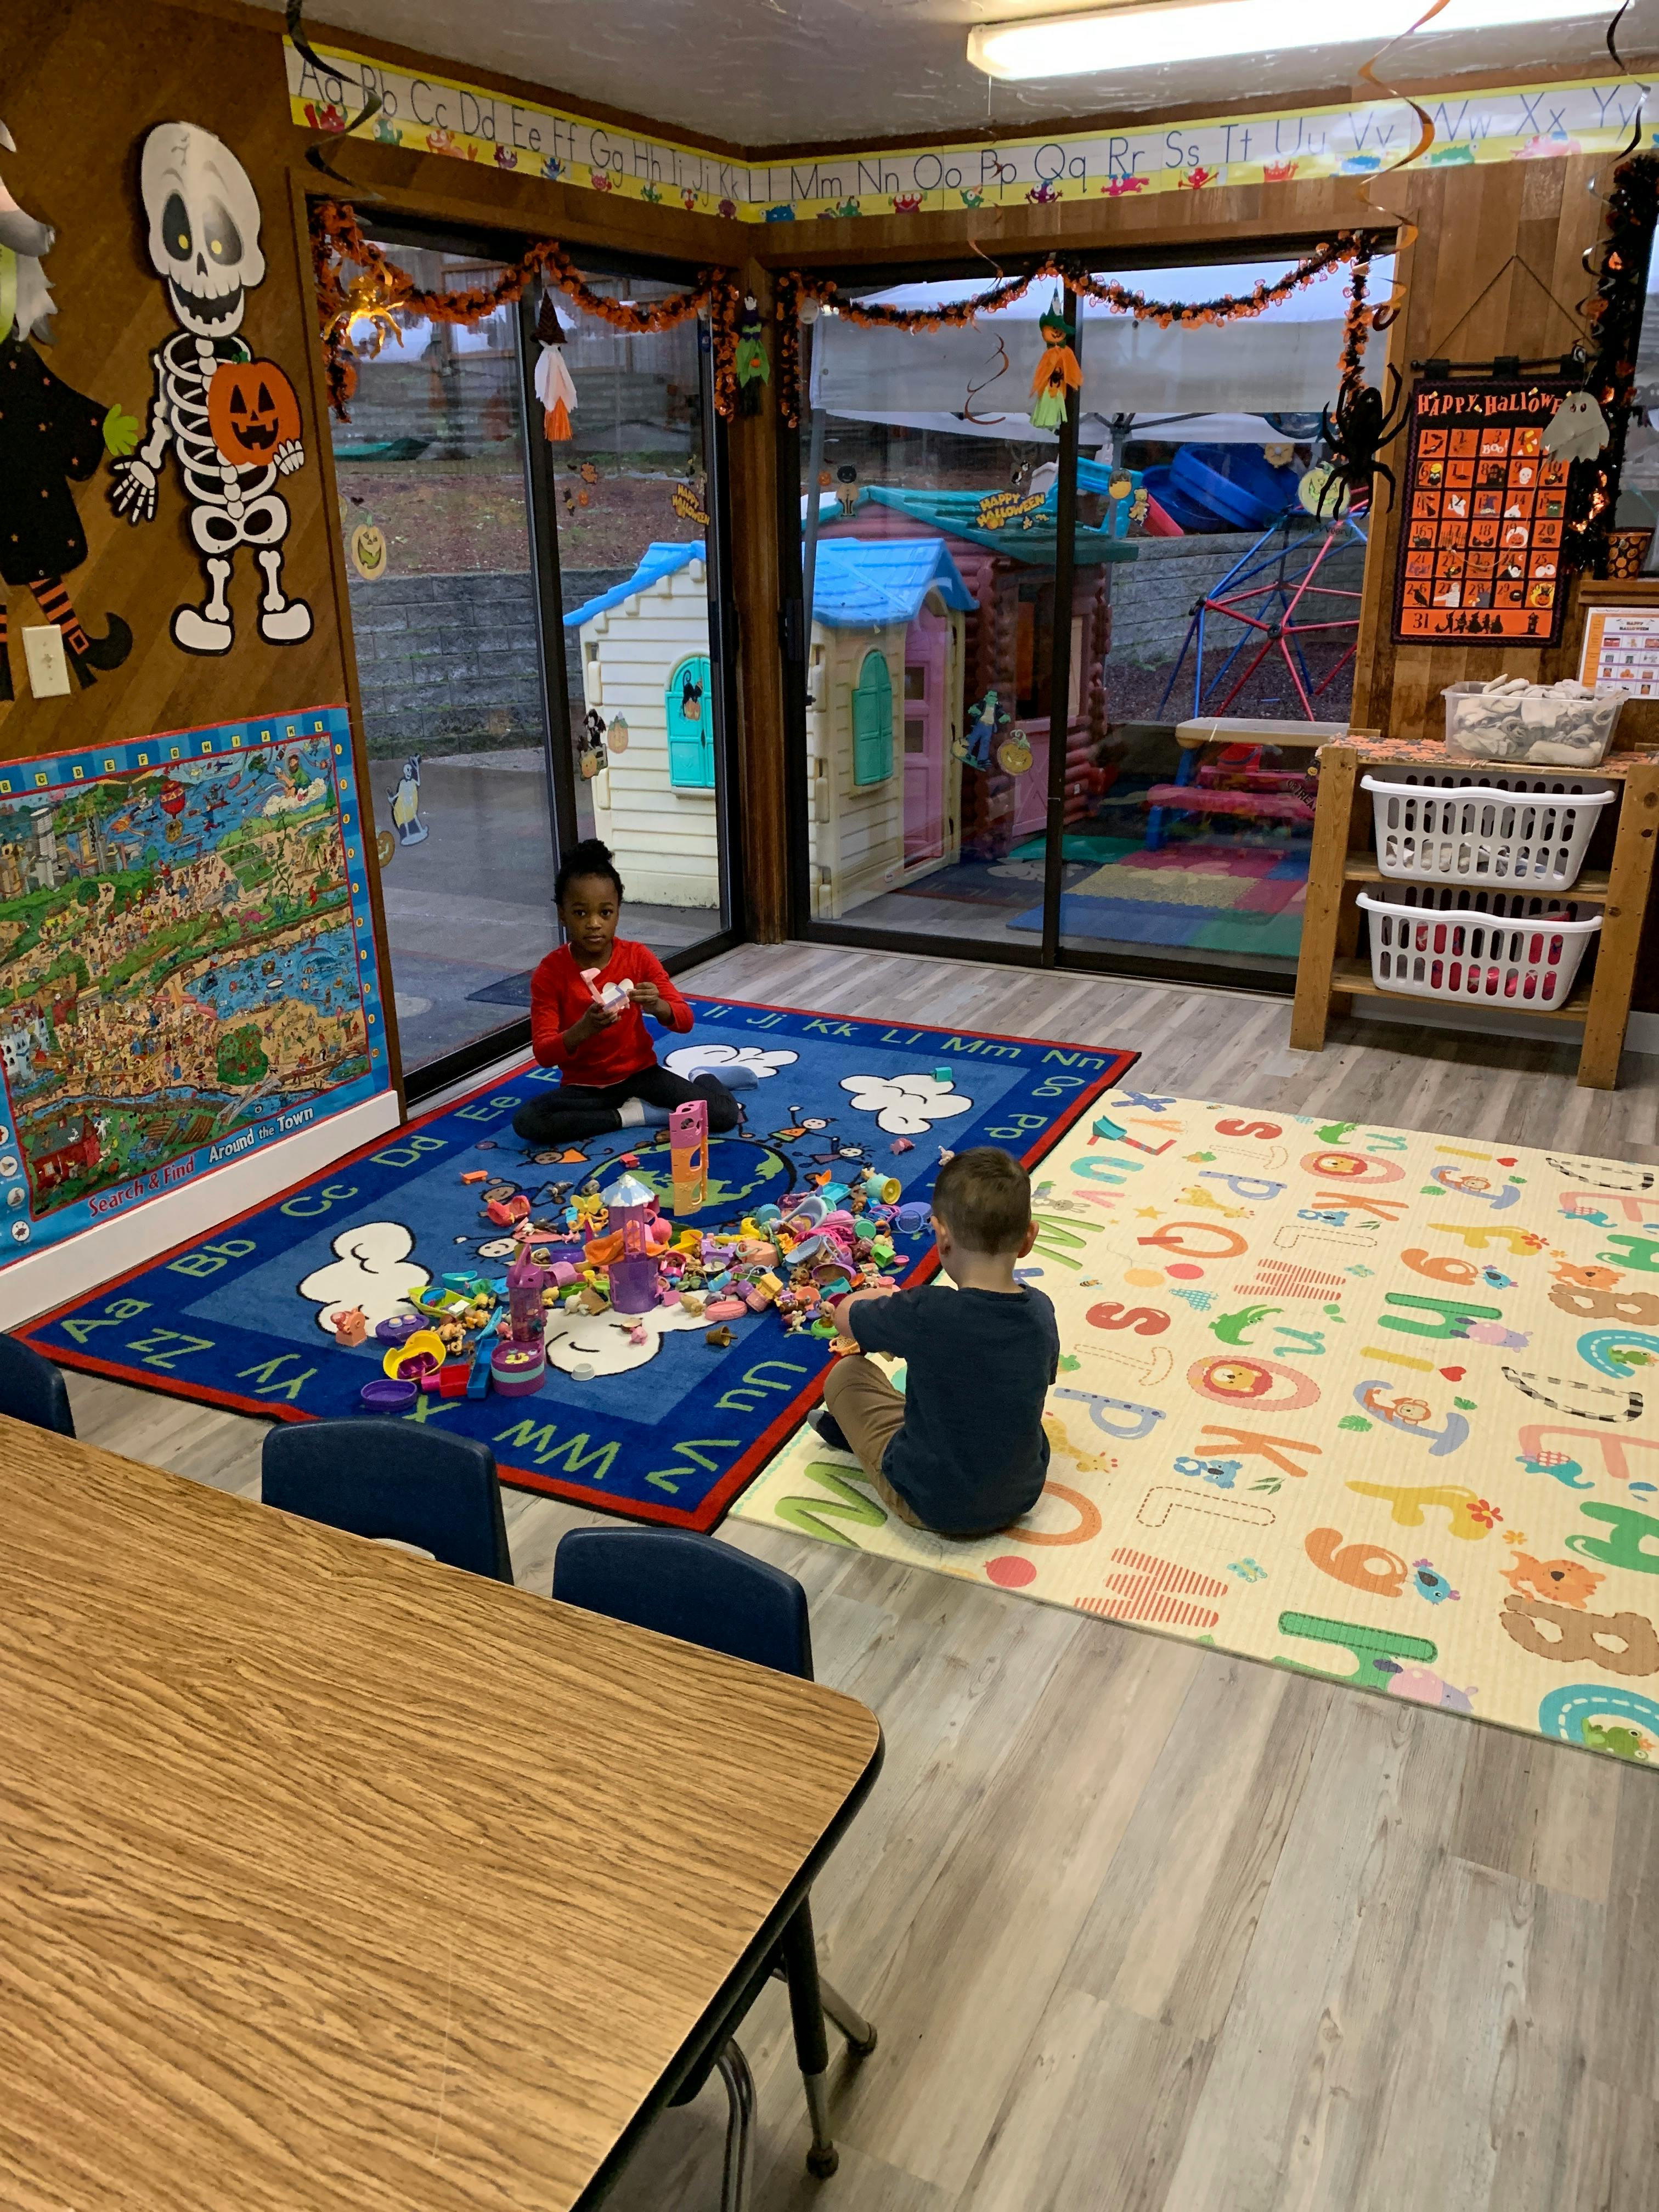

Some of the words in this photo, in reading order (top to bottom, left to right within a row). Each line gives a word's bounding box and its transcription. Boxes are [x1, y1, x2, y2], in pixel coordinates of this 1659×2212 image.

[298, 58, 343, 105] Aa
[360, 64, 397, 117] Bb
[410, 80, 447, 131] Cc
[460, 91, 496, 141] Dd
[510, 106, 541, 151] Ee
[553, 118, 576, 161] Ff
[590, 128, 625, 187] Gg
[633, 138, 661, 183] Hh
[671, 149, 682, 185] Ii
[691, 157, 709, 206] Jj
[719, 162, 739, 200] Kk
[748, 167, 772, 204] Ll
[791, 165, 843, 200] Mm
[857, 159, 900, 195] Nn
[913, 153, 962, 191] Oo
[981, 148, 1017, 200] Pp
[1034, 144, 1087, 194] Qq
[1109, 137, 1144, 174] Rr
[1165, 131, 1200, 168] Ss
[1220, 123, 1252, 163] Tt
[1276, 117, 1326, 156] Uu
[1348, 111, 1394, 151] Vv
[1419, 100, 1491, 142] Ww
[1514, 92, 1566, 136] Xx
[1592, 84, 1639, 144] Yy
[1418, 394, 1480, 416] HAPPY
[1423, 432, 1428, 444] 1
[1492, 430, 1502, 443] 3
[1518, 431, 1526, 445] 4
[977, 494, 1046, 528] HALLOWEEN
[980, 493, 1020, 511] HAPPY
[1514, 494, 1526, 505] 14
[1415, 524, 1427, 536] 16
[1479, 524, 1491, 536] 18
[1538, 523, 1556, 537] 20
[1414, 553, 1426, 563] 21
[1442, 554, 1455, 567] 22
[1534, 553, 1547, 565] 25
[1406, 583, 1426, 595] 26
[1497, 583, 1510, 595] 29
[1413, 613, 1429, 629] 31
[746, 1013, 787, 1029] Jj
[803, 1018, 861, 1037] Kk
[880, 1029, 924, 1045] Ll
[940, 1036, 1022, 1059] Mm
[1041, 1049, 1106, 1070] Nn
[1031, 1076, 1085, 1097] Oo
[988, 1113, 1048, 1139] Pp
[88, 1177, 144, 1218] Search
[148, 1173, 160, 1190] &
[163, 1155, 195, 1186] Find
[208, 1127, 255, 1164] Around
[258, 1126, 275, 1141] the
[276, 1106, 314, 1133] Town
[61, 1297, 153, 1344] Aa
[167, 1239, 256, 1278] Bb
[280, 1184, 359, 1217] Cc
[369, 1135, 449, 1168] Dd
[453, 1096, 522, 1123] Ee
[126, 1327, 216, 1369] Zz
[236, 1353, 318, 1400] Yy
[714, 1361, 808, 1412] Uu
[492, 1420, 623, 1480] Ww
[644, 1439, 742, 1493] Vv
